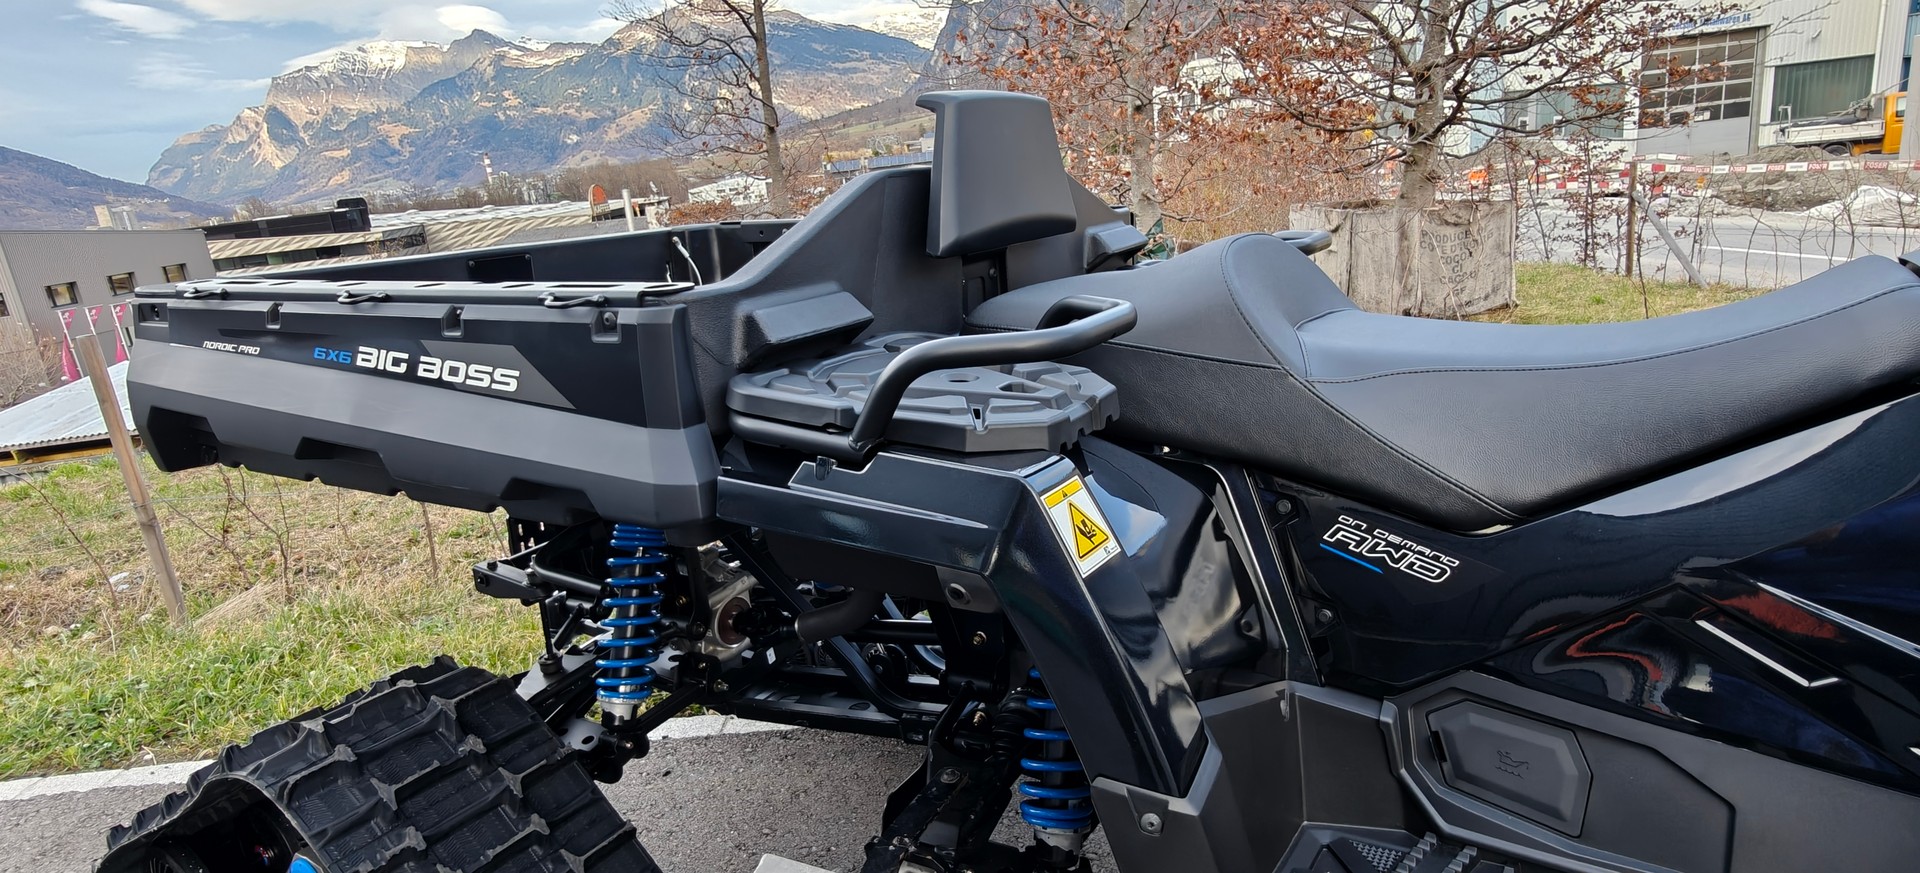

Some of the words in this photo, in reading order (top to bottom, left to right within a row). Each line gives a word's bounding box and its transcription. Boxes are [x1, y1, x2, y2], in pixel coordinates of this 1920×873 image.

[1742, 13, 1751, 22] AG
[1865, 161, 1888, 169] FOSER
[1440, 251, 1472, 265] COCO
[203, 340, 237, 353] NORDIC
[238, 345, 261, 355] PRO
[313, 347, 353, 364] 6X6
[356, 345, 410, 374] BIG
[417, 355, 520, 393] BOSS
[1338, 514, 1367, 530] ON
[1373, 528, 1460, 567] DEMAND
[1322, 523, 1451, 583] AWD
